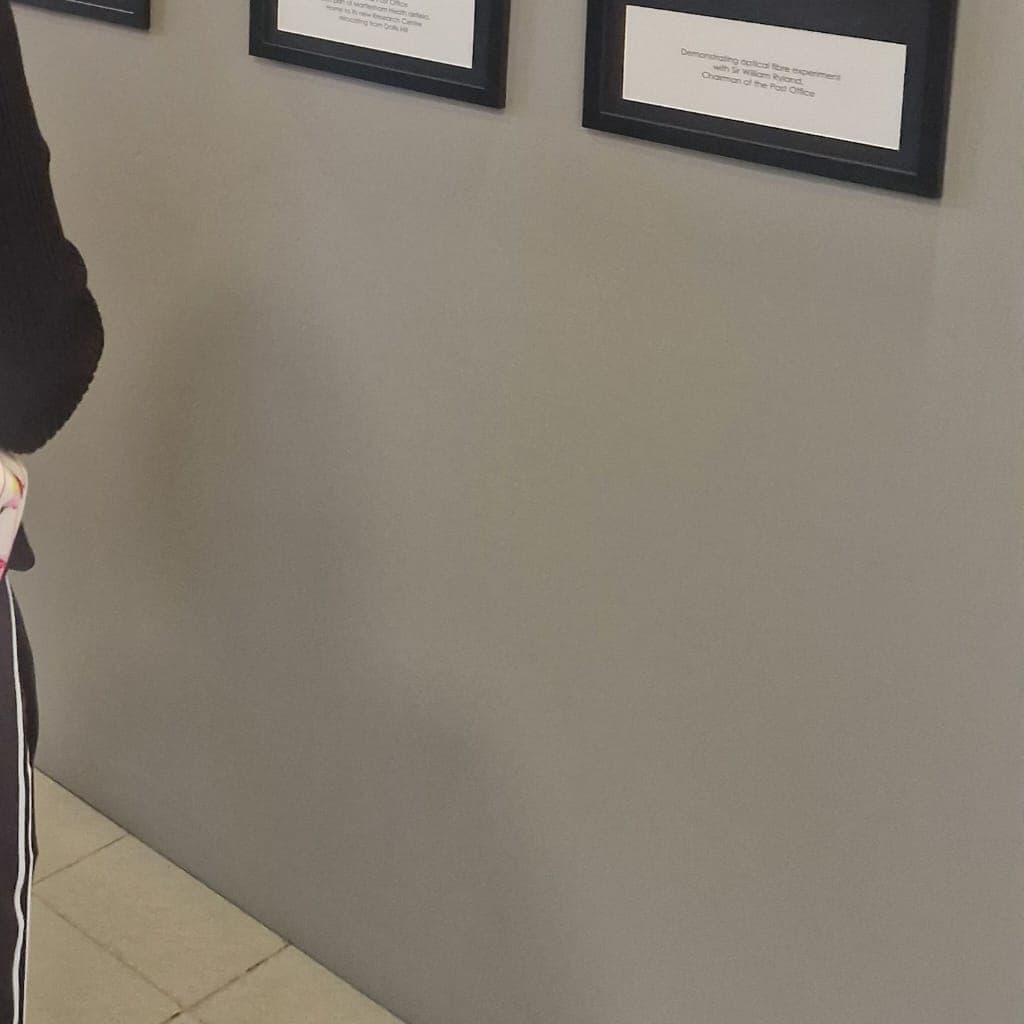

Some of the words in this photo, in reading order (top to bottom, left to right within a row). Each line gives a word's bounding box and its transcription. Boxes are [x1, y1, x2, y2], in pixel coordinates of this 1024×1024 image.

[401, 17, 422, 27] Centre
[680, 48, 739, 66] Demonstrating
[740, 58, 770, 70] optical
[771, 62, 790, 73] fibre
[792, 67, 841, 81] experiment
[713, 63, 729, 73] with
[731, 65, 740, 74] Sir
[742, 67, 771, 80] William
[701, 71, 742, 85] Chairman
[754, 80, 768, 89] the
[769, 83, 787, 92] Post
[788, 85, 816, 98] Office
